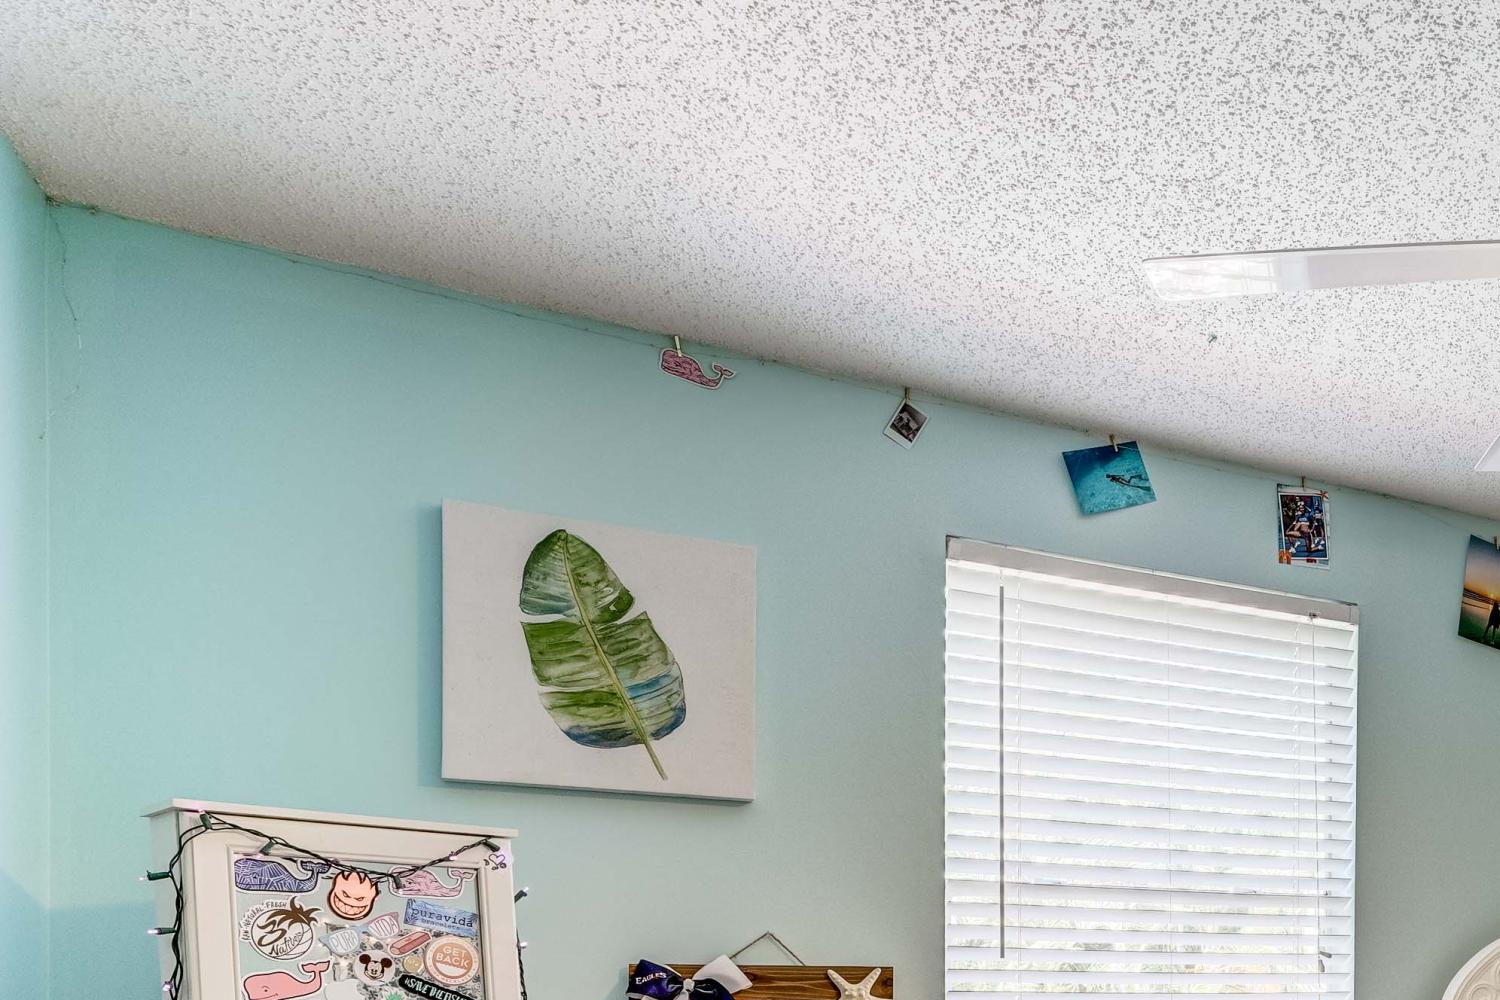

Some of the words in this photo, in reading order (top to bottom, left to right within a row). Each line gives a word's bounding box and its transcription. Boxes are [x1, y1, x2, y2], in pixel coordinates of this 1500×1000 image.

[372, 915, 399, 936] VIDA
[411, 906, 475, 928] puravida
[330, 929, 359, 951] PURA
[436, 952, 471, 968] BACK
[443, 946, 467, 958] GET
[635, 972, 667, 985] EAGLES
